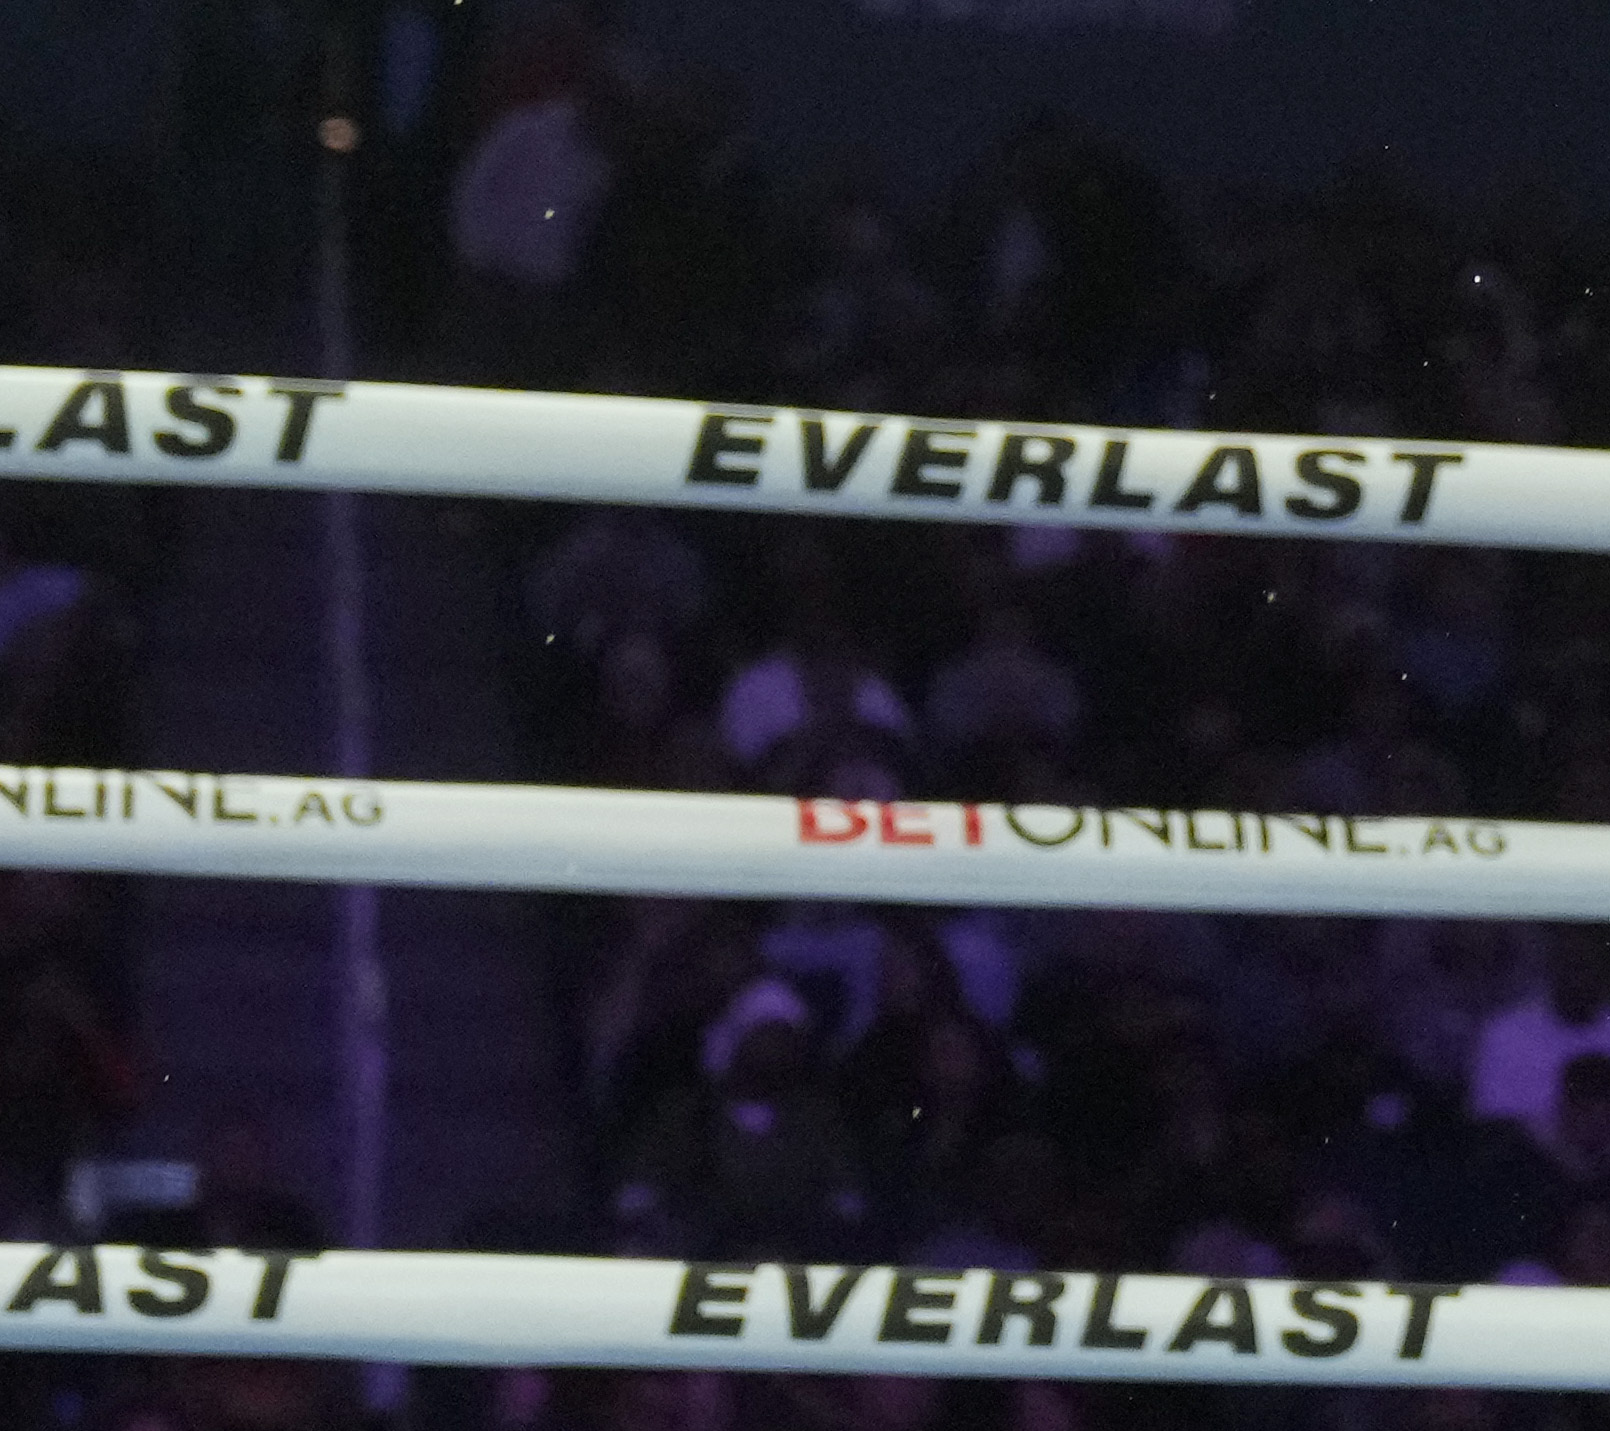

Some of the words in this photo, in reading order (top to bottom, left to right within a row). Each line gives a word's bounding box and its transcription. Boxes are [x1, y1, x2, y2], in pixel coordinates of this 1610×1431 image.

[686, 410, 1465, 526] EVERLAST
[798, 798, 1508, 859] BETONLINE.AG
[667, 1261, 1463, 1360] EVERLAST
